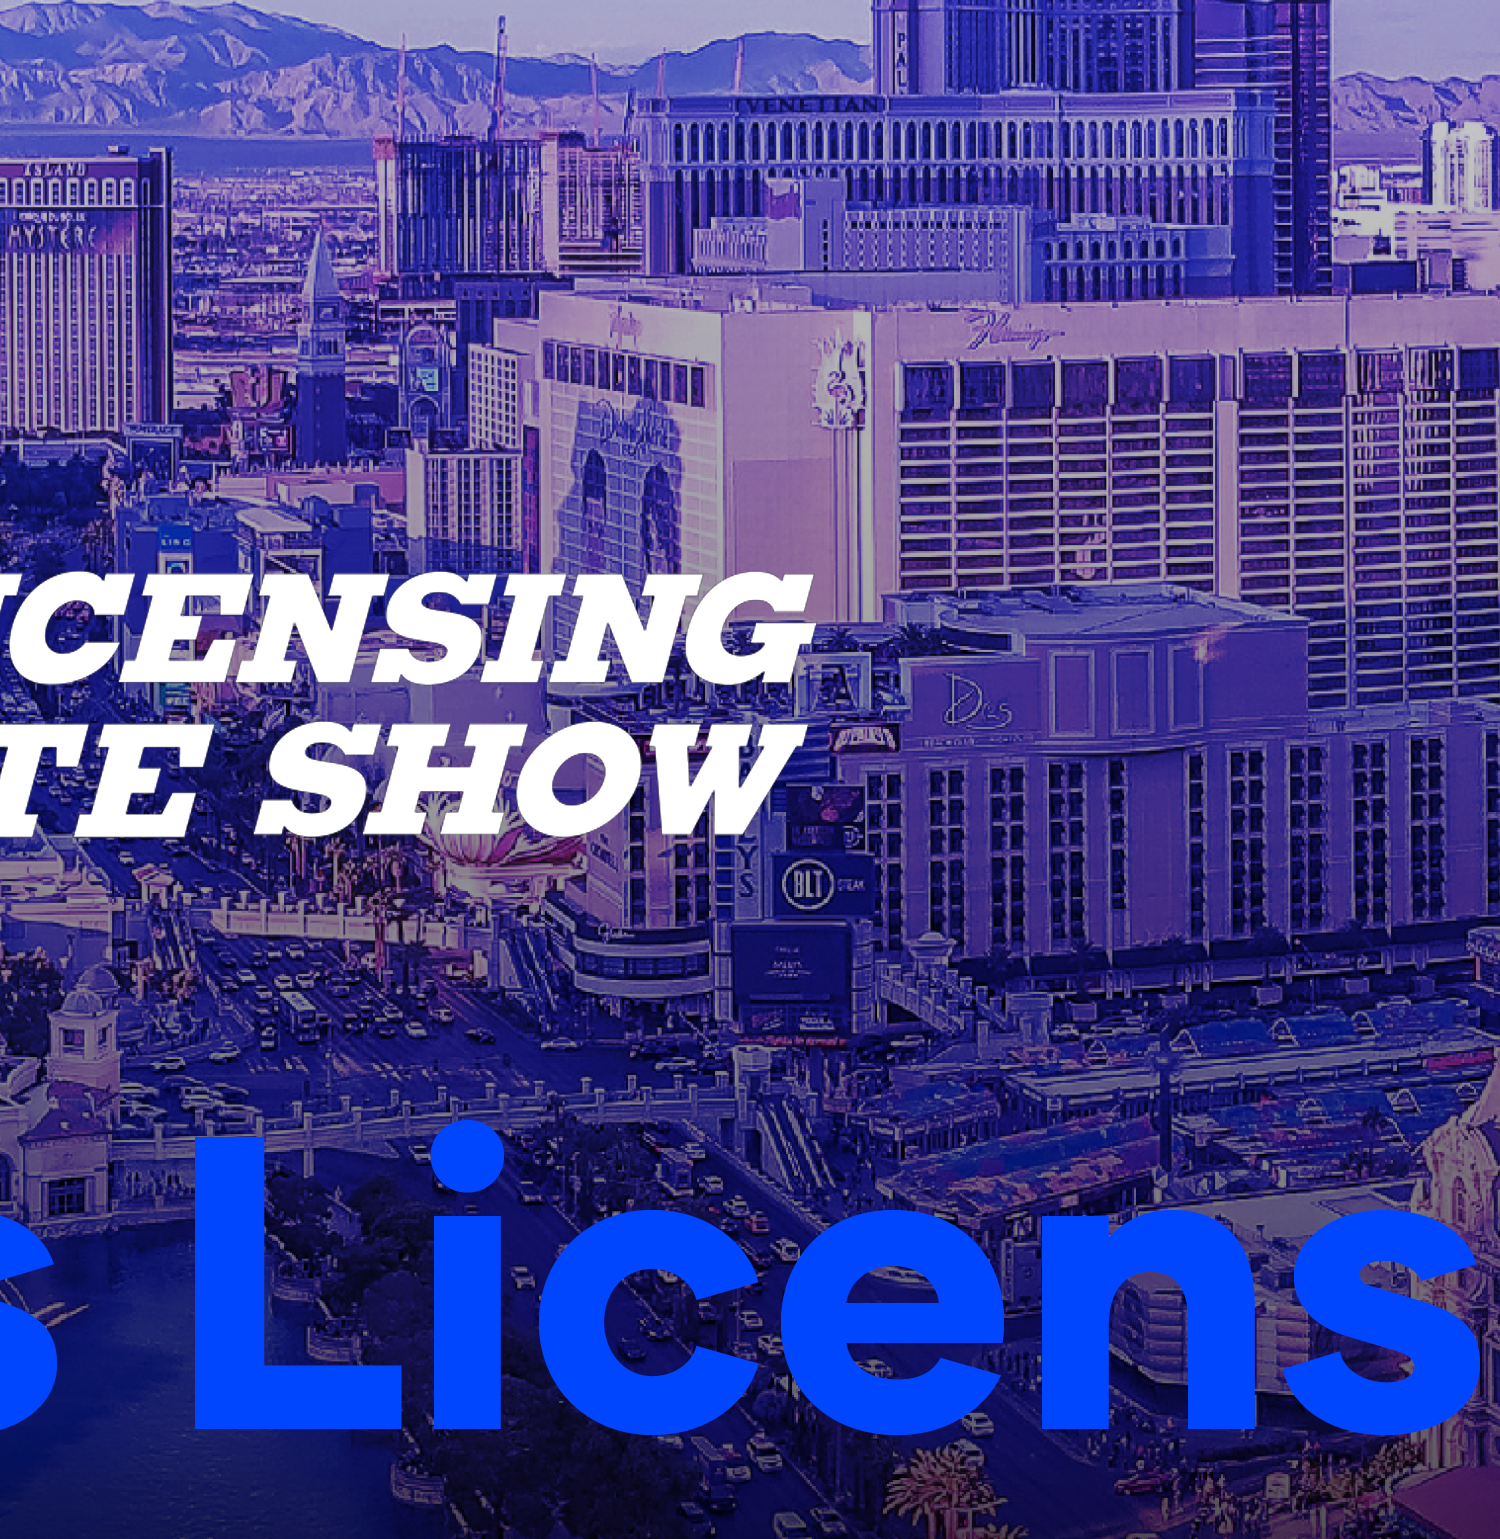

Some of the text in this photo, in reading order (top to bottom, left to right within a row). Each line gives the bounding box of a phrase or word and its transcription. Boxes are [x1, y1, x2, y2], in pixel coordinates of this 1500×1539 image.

[896, 33, 907, 95] PAL
[746, 98, 879, 113] VENETIAN
[23, 162, 86, 177] ISLAND
[793, 868, 824, 898] BLT
